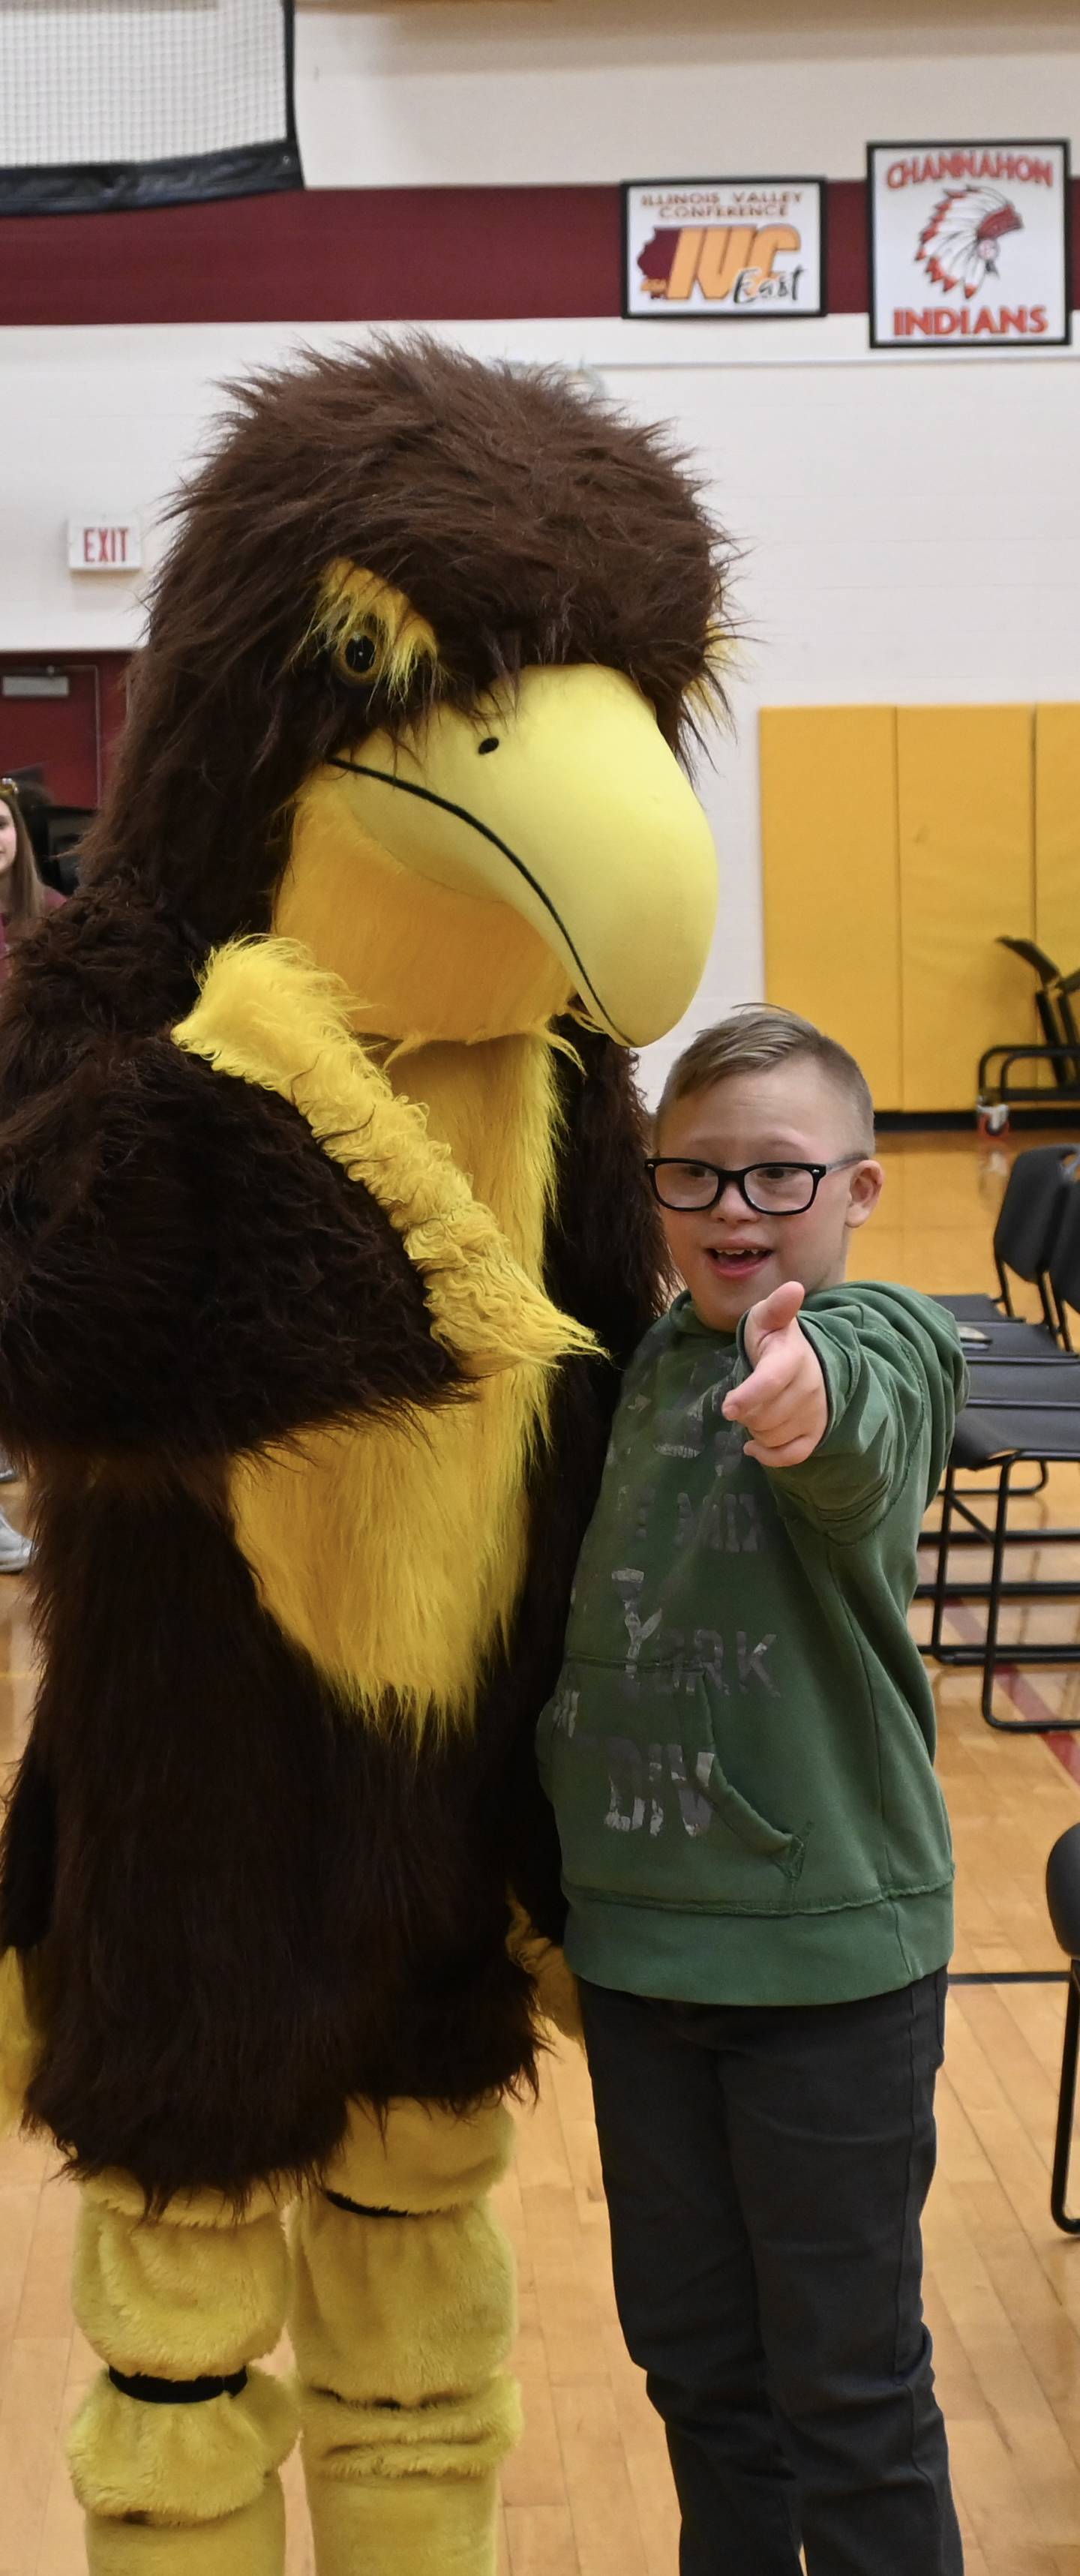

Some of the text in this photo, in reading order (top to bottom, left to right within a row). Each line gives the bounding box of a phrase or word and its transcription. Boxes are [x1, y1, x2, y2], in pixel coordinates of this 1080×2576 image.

[886, 150, 1053, 190] CHANNAHON
[641, 191, 802, 206] ILLINOIS VALLEY
[659, 204, 788, 217] CONFERENCE
[733, 265, 806, 304] East
[893, 306, 1048, 336] INDIANS
[83, 526, 129, 563] EXIT
